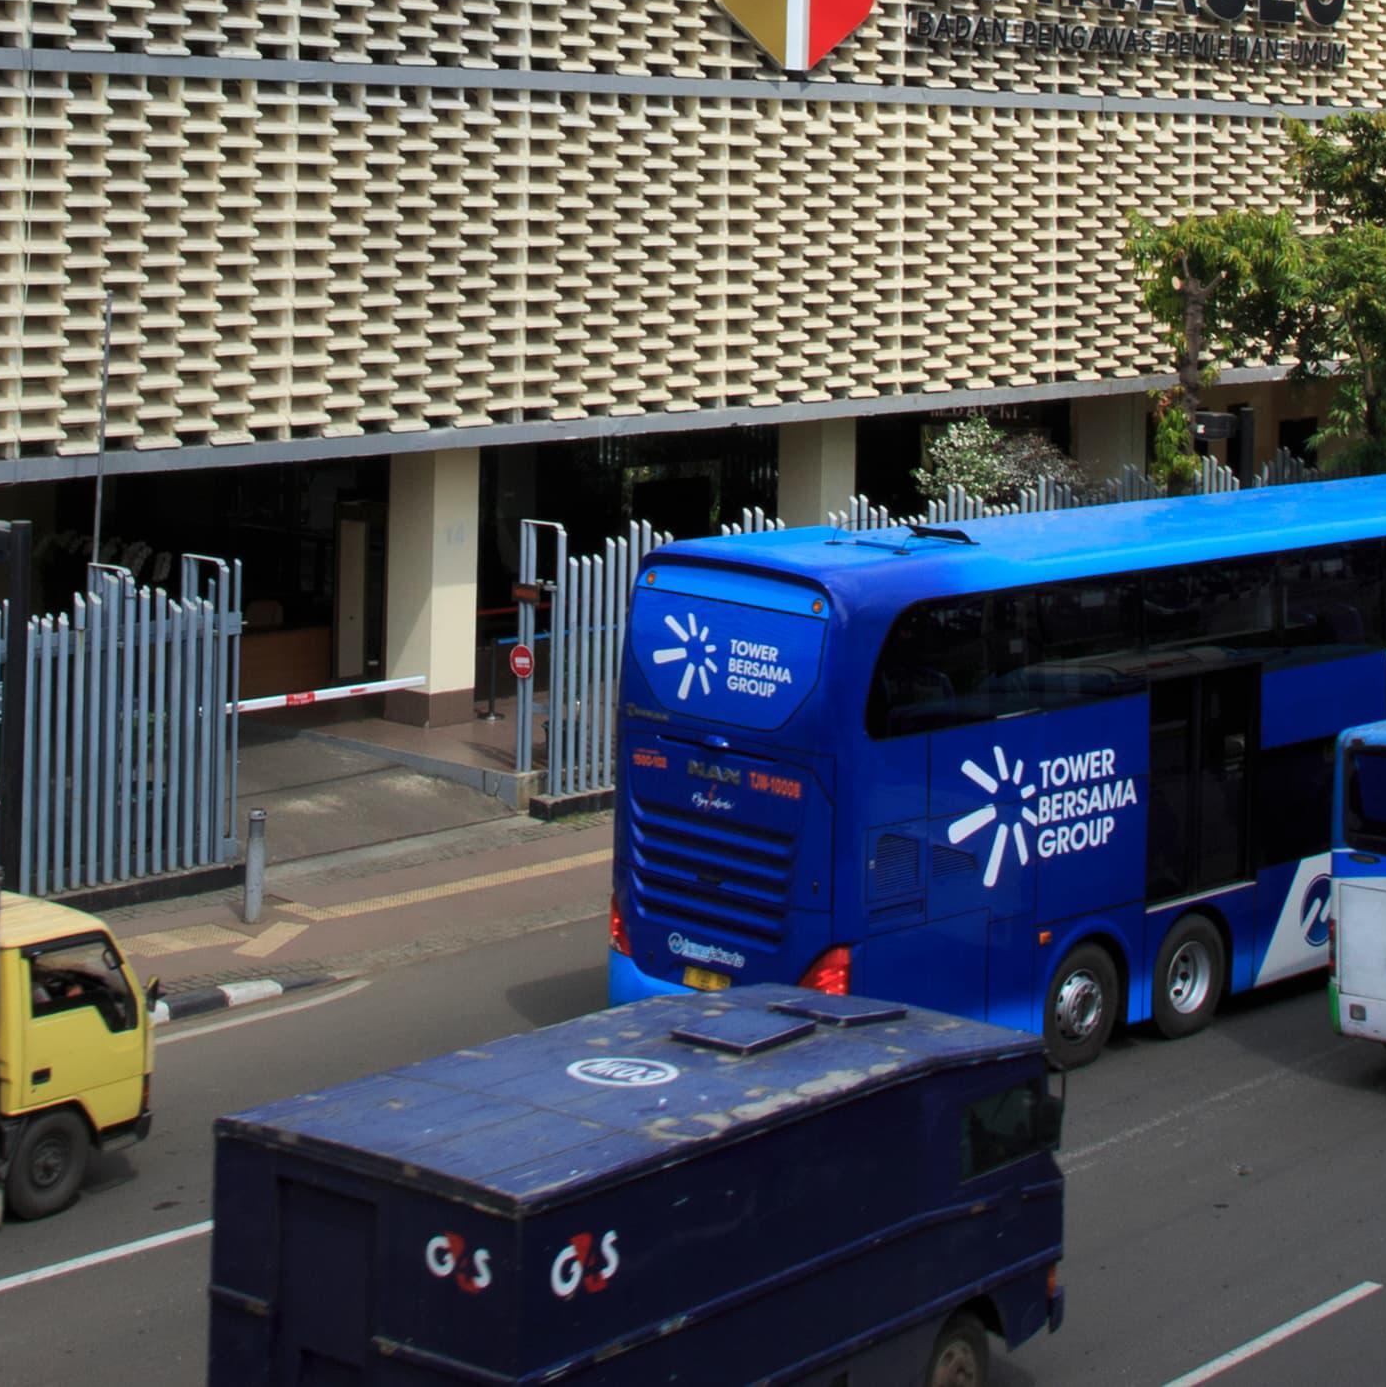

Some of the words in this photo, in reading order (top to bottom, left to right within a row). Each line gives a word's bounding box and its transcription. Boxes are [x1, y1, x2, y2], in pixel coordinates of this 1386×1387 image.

[916, 11, 1008, 44] BADAN
[1021, 21, 1153, 54] PENGAWAS
[1164, 32, 1280, 62] PEMILIHAN
[1290, 40, 1347, 65] UMUM
[728, 657, 792, 684] BERSAMA
[729, 639, 779, 662] TOWER
[726, 675, 776, 698] GROUP
[1039, 748, 1115, 789] TOWER
[1038, 779, 1137, 824] BERSAMA
[1037, 816, 1115, 858] GROUP
[426, 1231, 491, 1294] G4S
[551, 1230, 619, 1298] G4S
